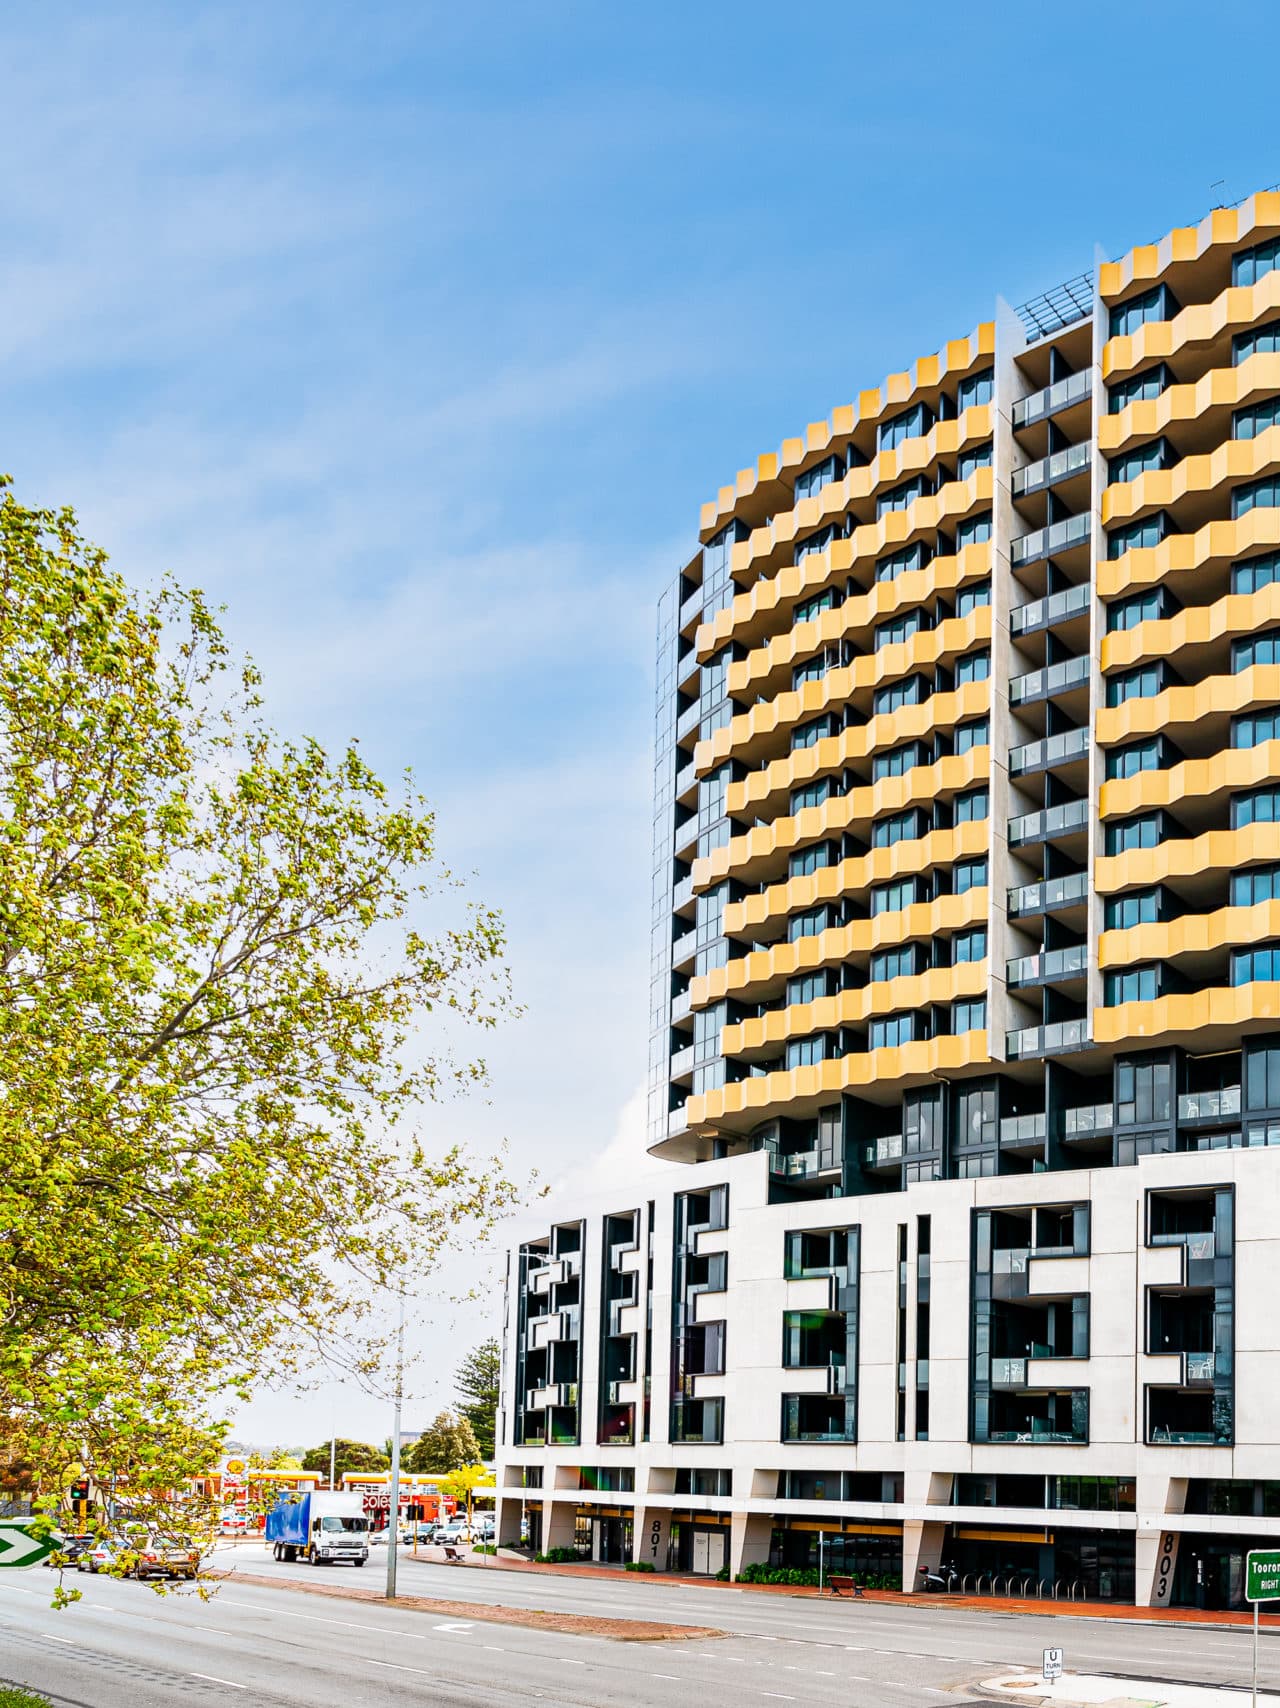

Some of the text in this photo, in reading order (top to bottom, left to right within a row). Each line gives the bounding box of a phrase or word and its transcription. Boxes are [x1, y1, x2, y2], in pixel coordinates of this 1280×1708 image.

[651, 1520, 661, 1557] 801
[1157, 1534, 1173, 1597] 803
[1261, 1580, 1279, 1590] RIGHT
[1050, 1651, 1057, 1661] U
